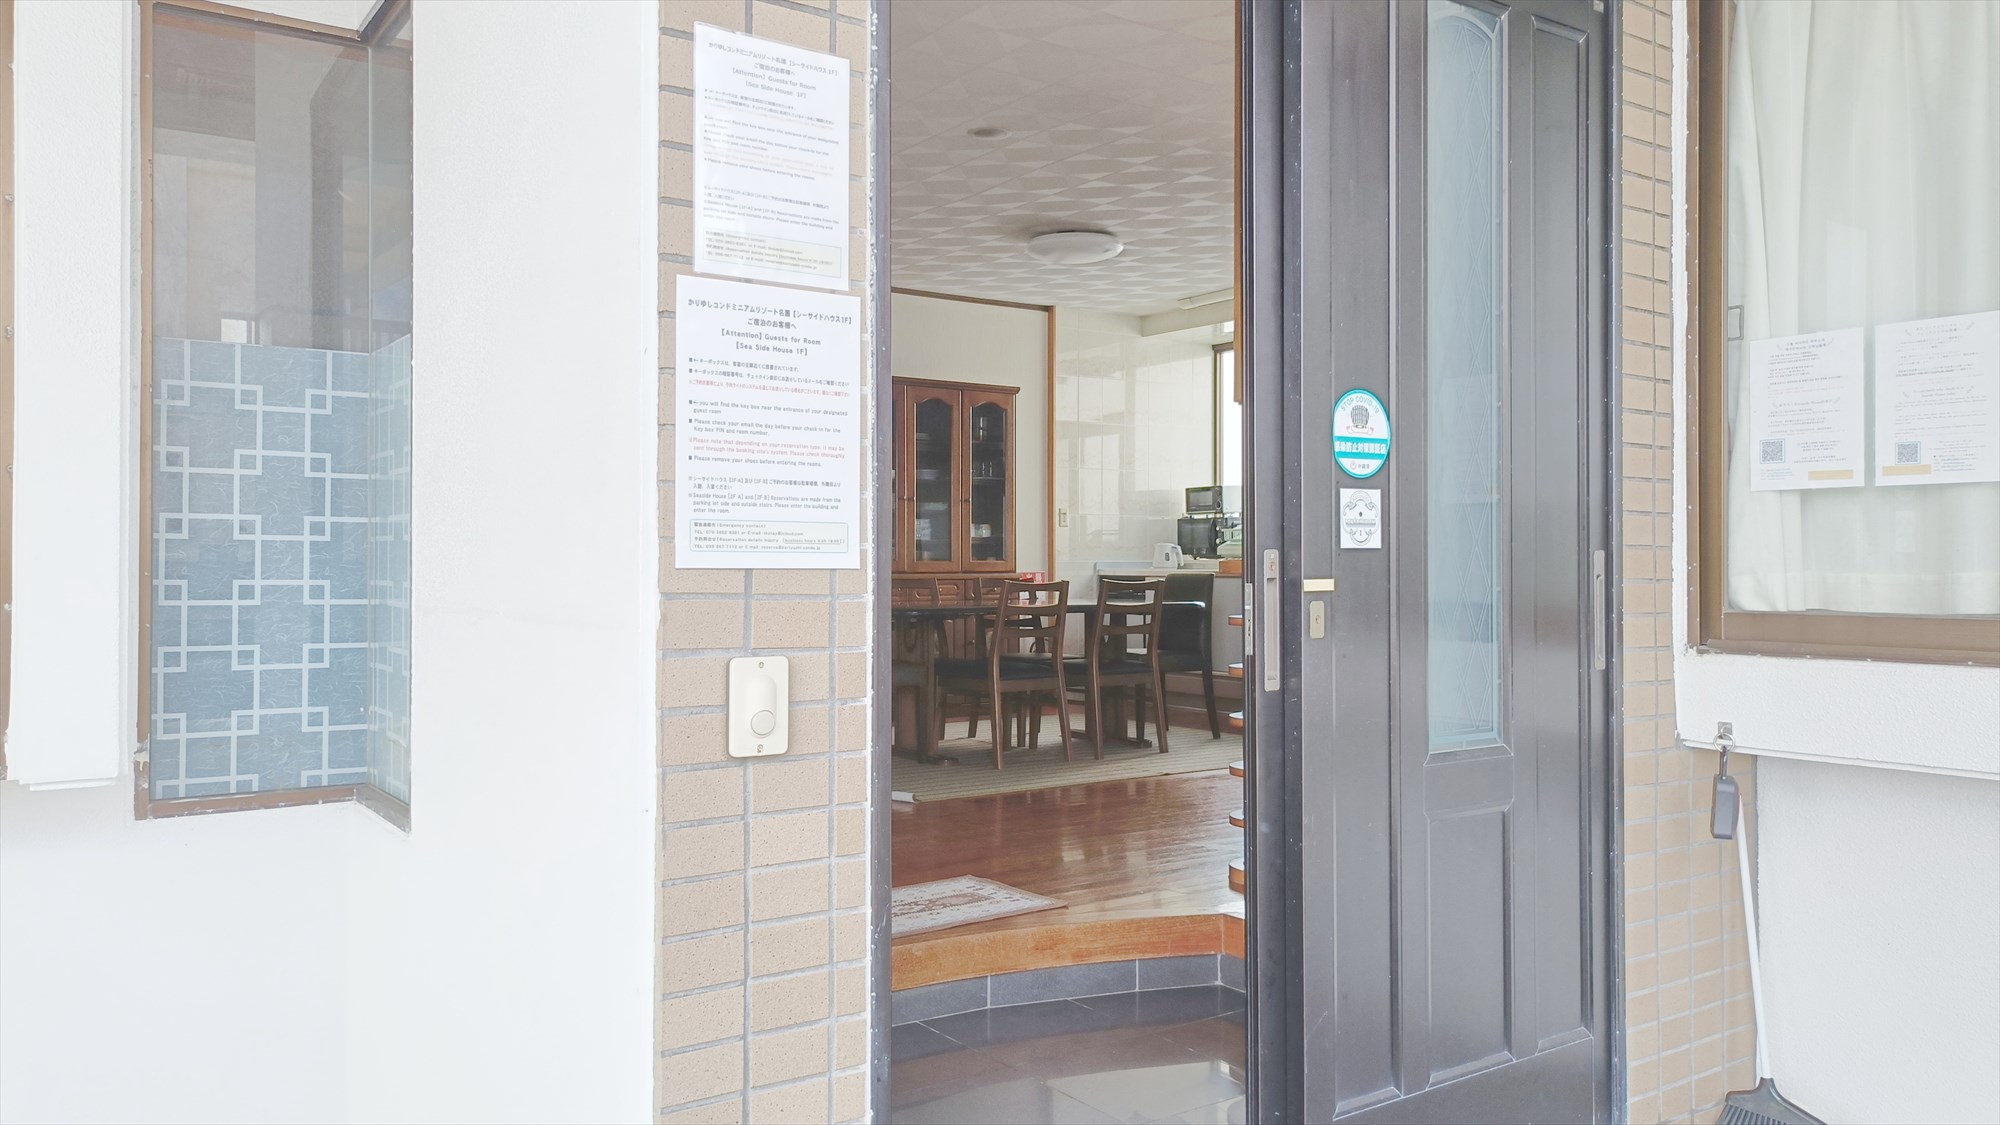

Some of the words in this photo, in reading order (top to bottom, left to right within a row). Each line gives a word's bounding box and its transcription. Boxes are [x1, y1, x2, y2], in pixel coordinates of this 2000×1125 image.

[764, 334, 788, 342] Guests
[756, 344, 770, 352] Side
[1341, 396, 1354, 412] STOP
[1355, 395, 1380, 414] COVID-19
